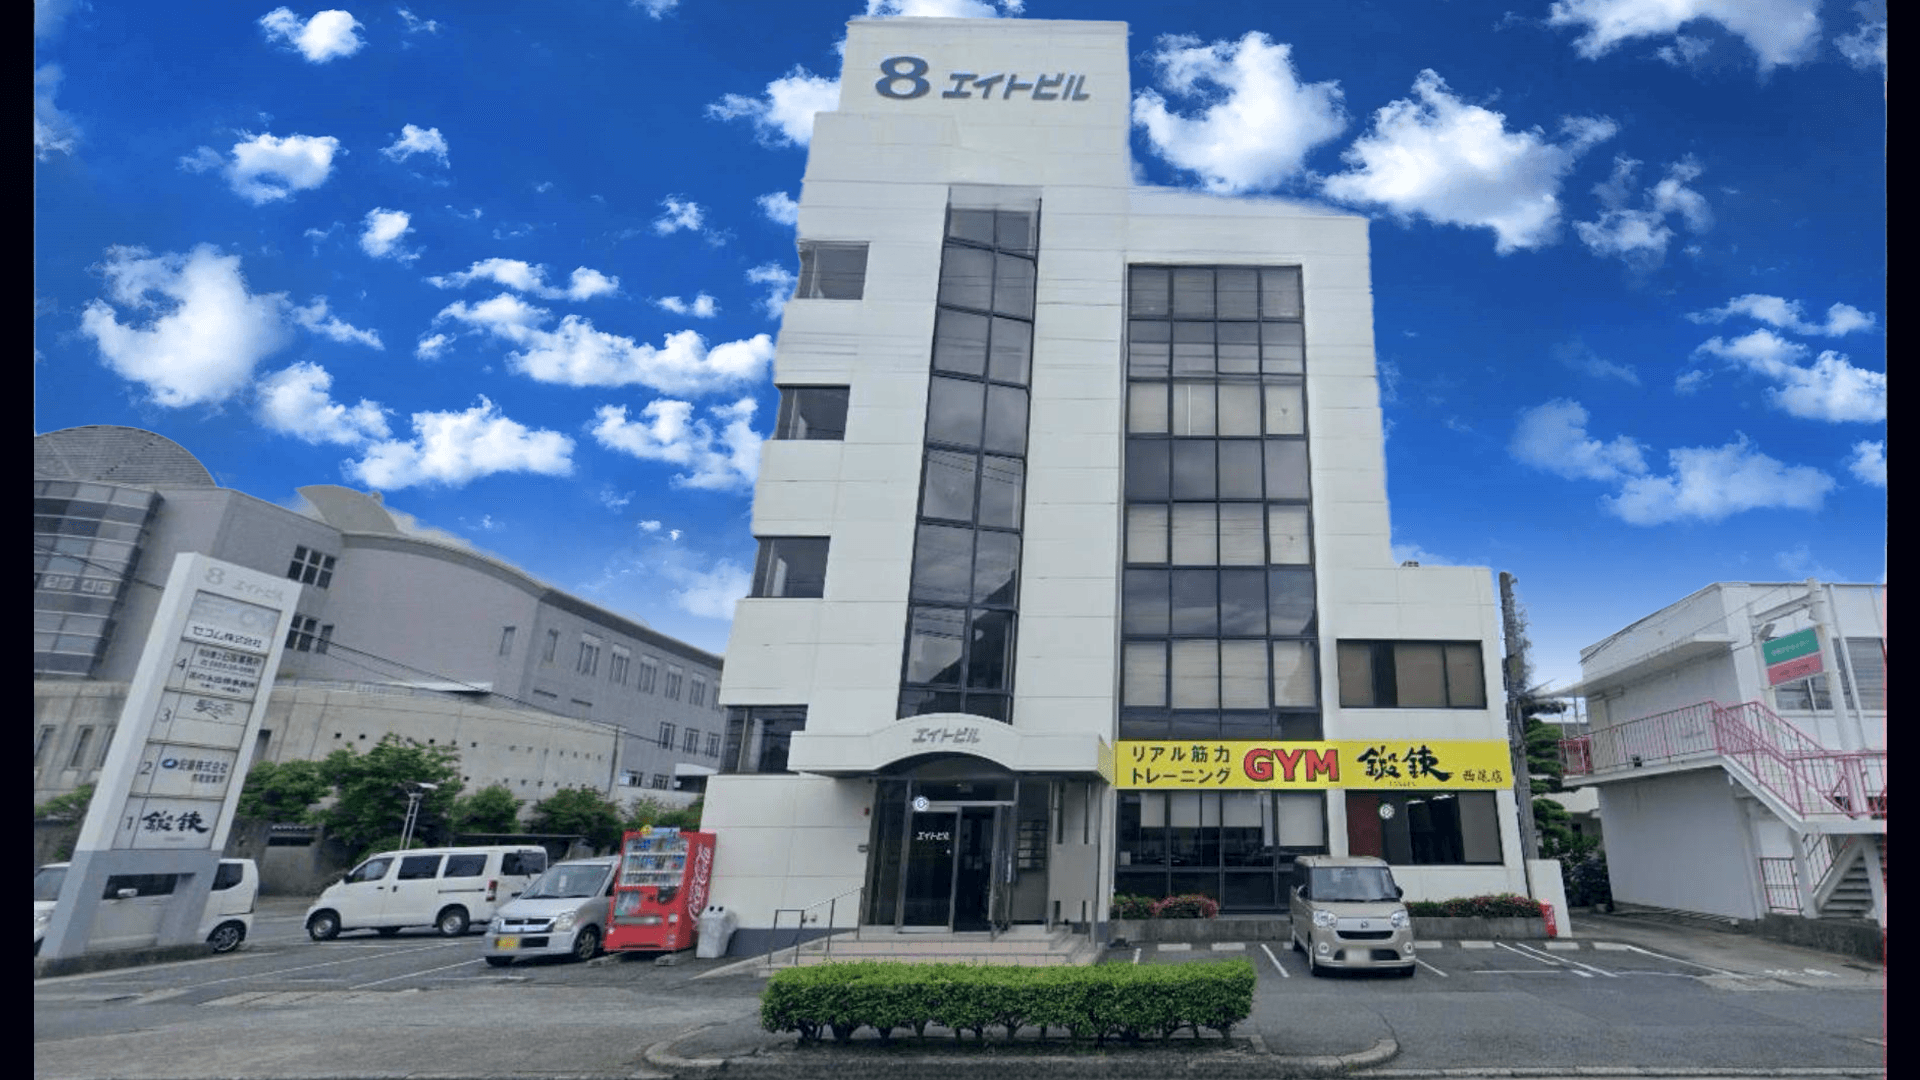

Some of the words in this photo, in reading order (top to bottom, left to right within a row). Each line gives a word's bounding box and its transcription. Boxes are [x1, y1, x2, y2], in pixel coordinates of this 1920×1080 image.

[875, 56, 931, 100] 8
[942, 72, 1091, 101] エイトビル
[205, 567, 226, 585] 8
[193, 625, 263, 648] セコム株式会社
[176, 658, 187, 671] 4
[159, 707, 172, 723] 3
[912, 727, 980, 743] エイトビル
[1133, 745, 1230, 763] リアル筋力
[140, 761, 153, 775] 2
[1243, 748, 1340, 783] GYM
[1132, 767, 1231, 785] トレーニング
[1462, 768, 1503, 783] 西尾店
[126, 816, 134, 830] 1
[916, 831, 949, 841] エイトビル
